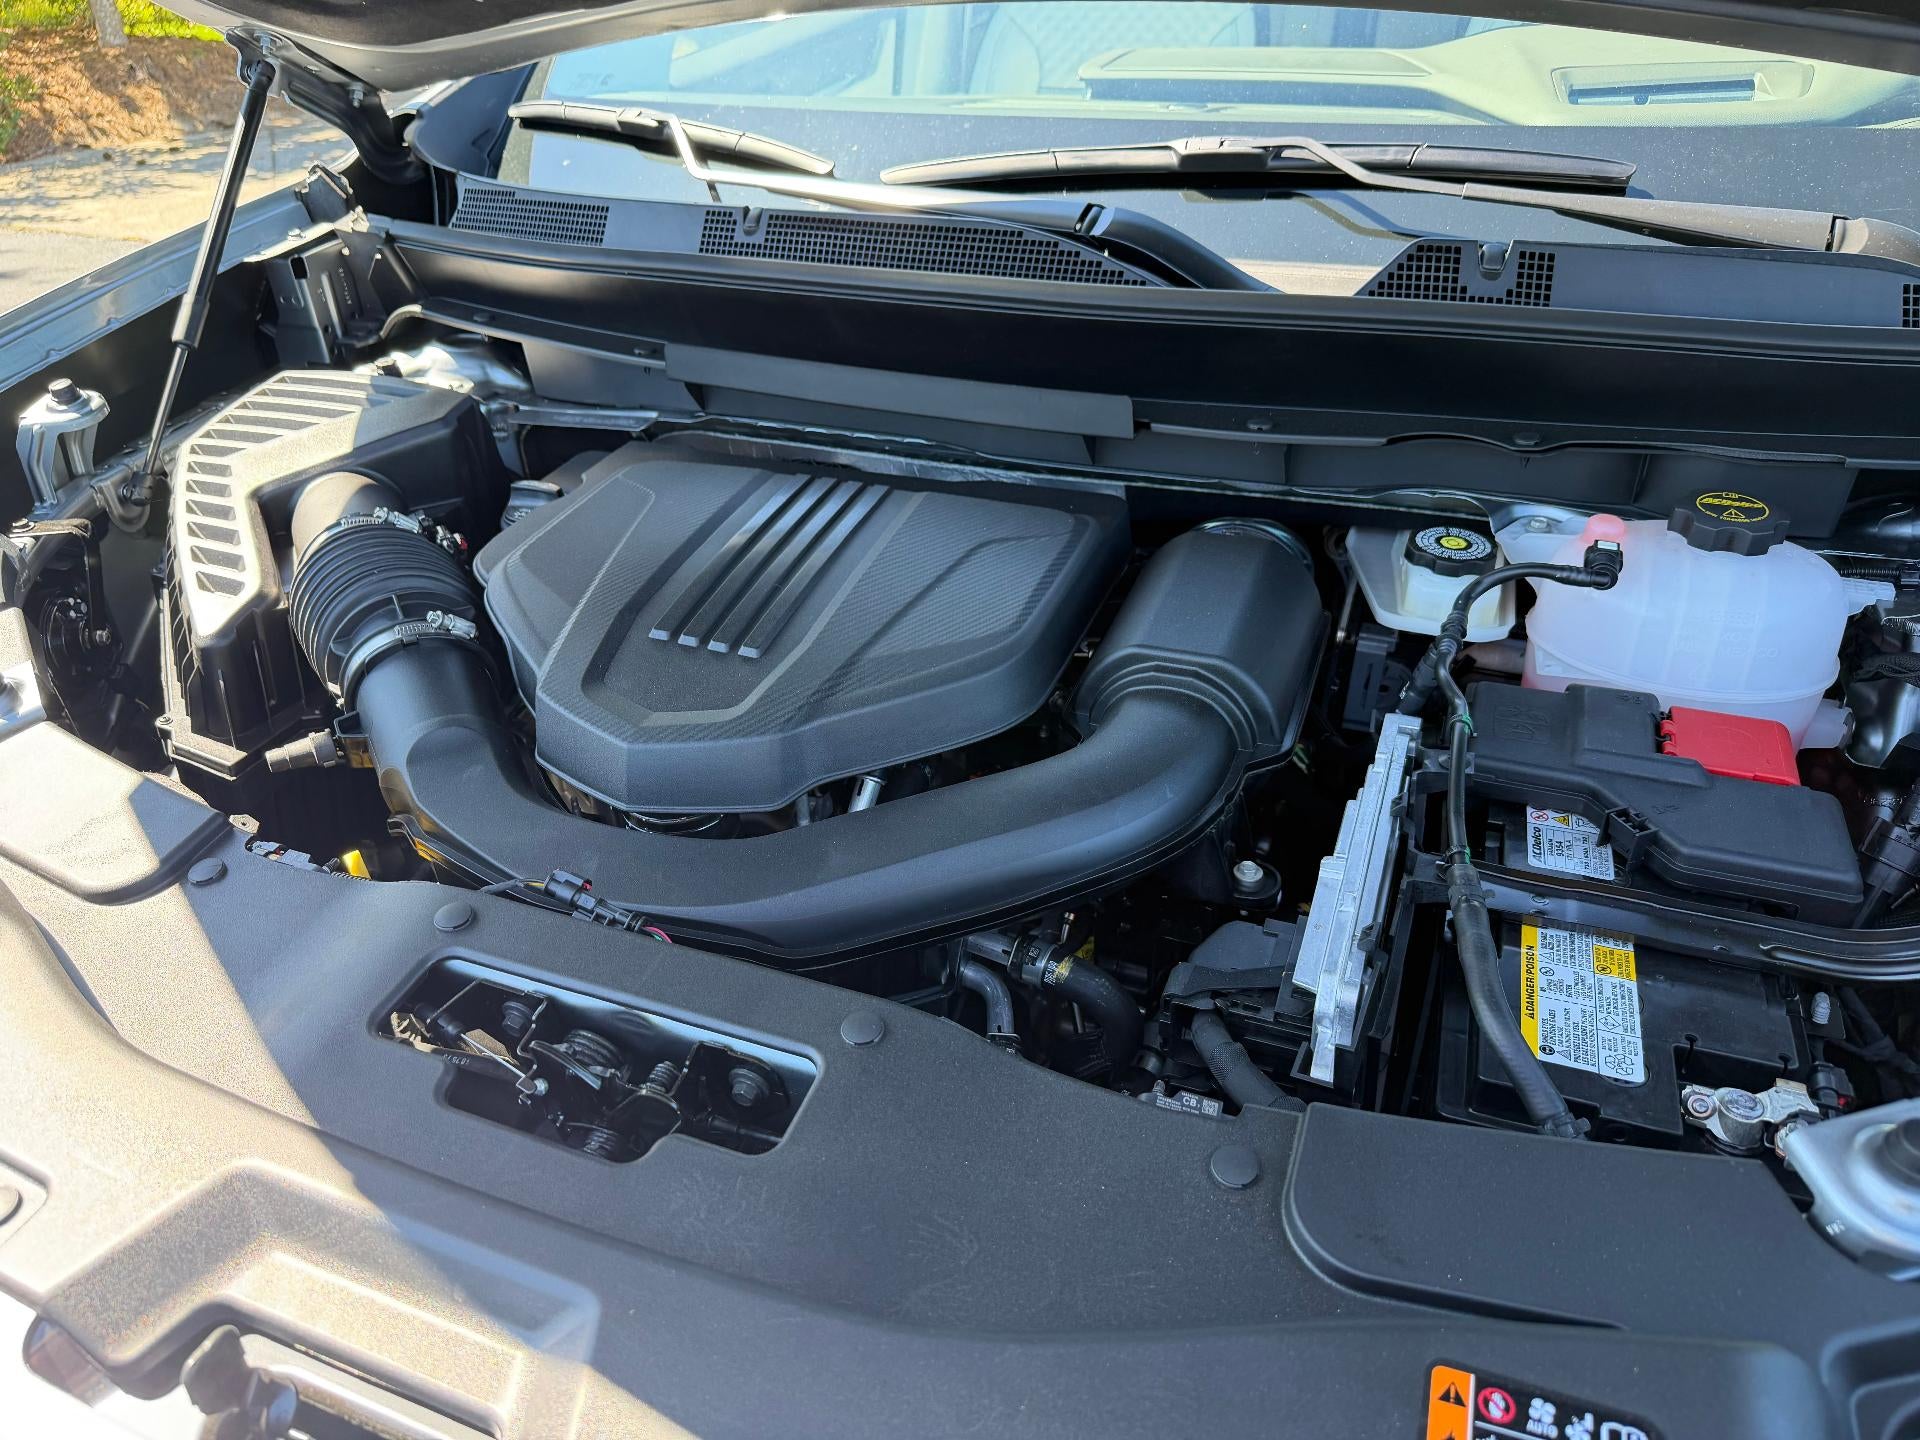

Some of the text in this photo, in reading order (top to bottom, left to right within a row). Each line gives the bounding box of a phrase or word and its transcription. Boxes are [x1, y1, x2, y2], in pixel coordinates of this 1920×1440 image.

[1531, 826, 1543, 863] ACDelco
[1525, 945, 1535, 1012] DANGER/POISON
[1526, 1418, 1558, 1439] AUTO
